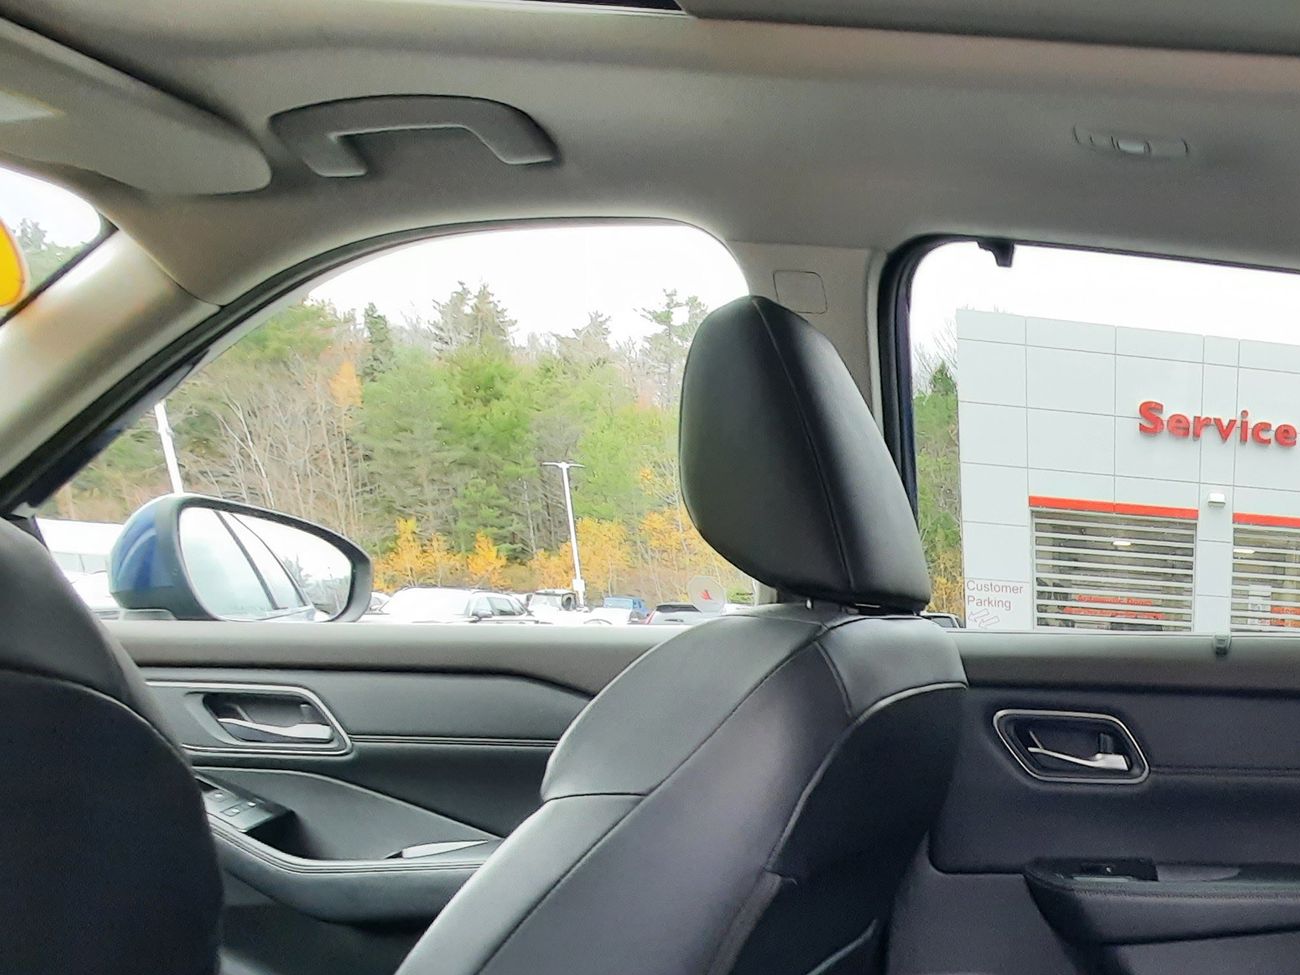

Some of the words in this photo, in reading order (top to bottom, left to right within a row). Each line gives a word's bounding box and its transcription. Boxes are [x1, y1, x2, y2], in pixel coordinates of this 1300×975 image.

[1138, 400, 1298, 447] Service
[967, 580, 1024, 594] Customer
[967, 595, 1012, 611] Parking
